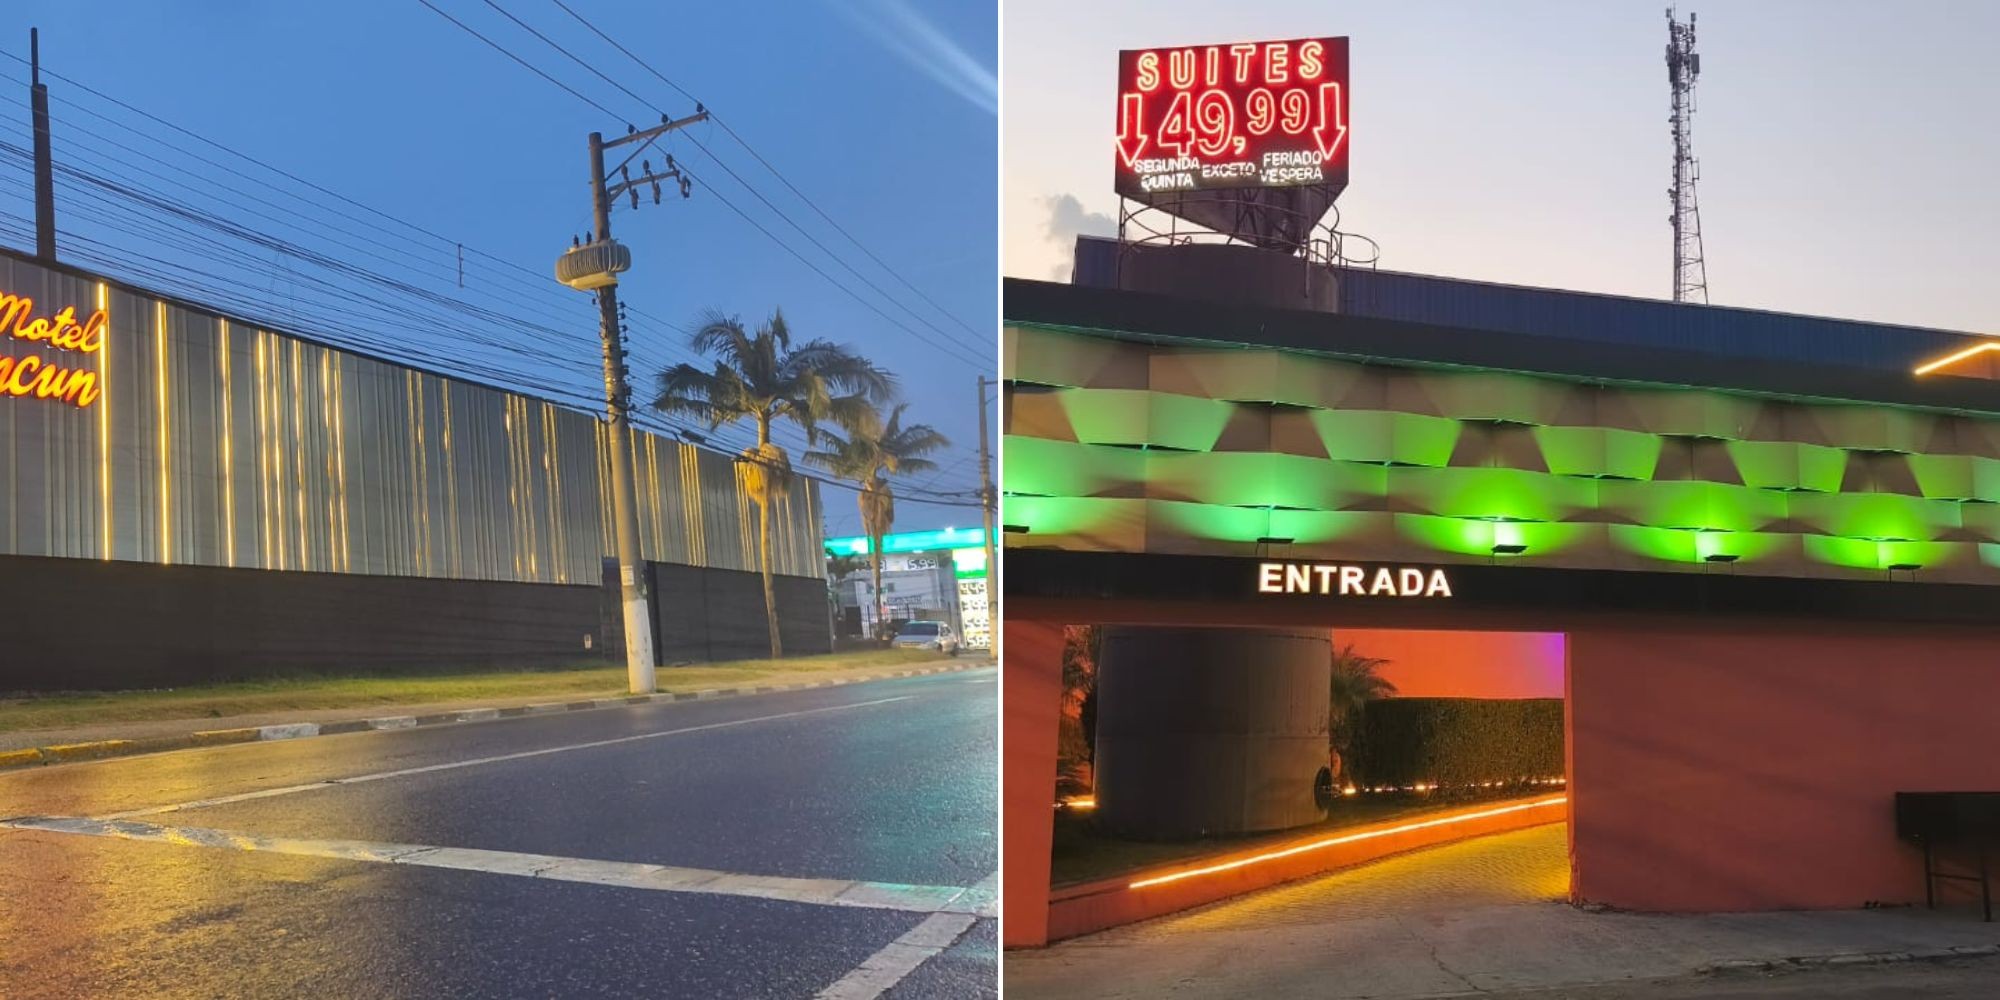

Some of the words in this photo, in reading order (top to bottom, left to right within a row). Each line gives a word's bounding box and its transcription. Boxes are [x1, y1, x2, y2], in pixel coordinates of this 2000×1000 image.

[1137, 41, 1323, 91] SUITES
[1157, 87, 1310, 157] 49,99
[1134, 157, 1200, 174] SEGUNDA
[1263, 151, 1323, 167] FERIADO
[1202, 162, 1256, 178] EXCETO
[1260, 167, 1323, 182] VESPERA
[1141, 173, 1194, 191] QUINTA
[0, 291, 108, 352] Motel
[1259, 563, 1452, 597] ENTRADA
